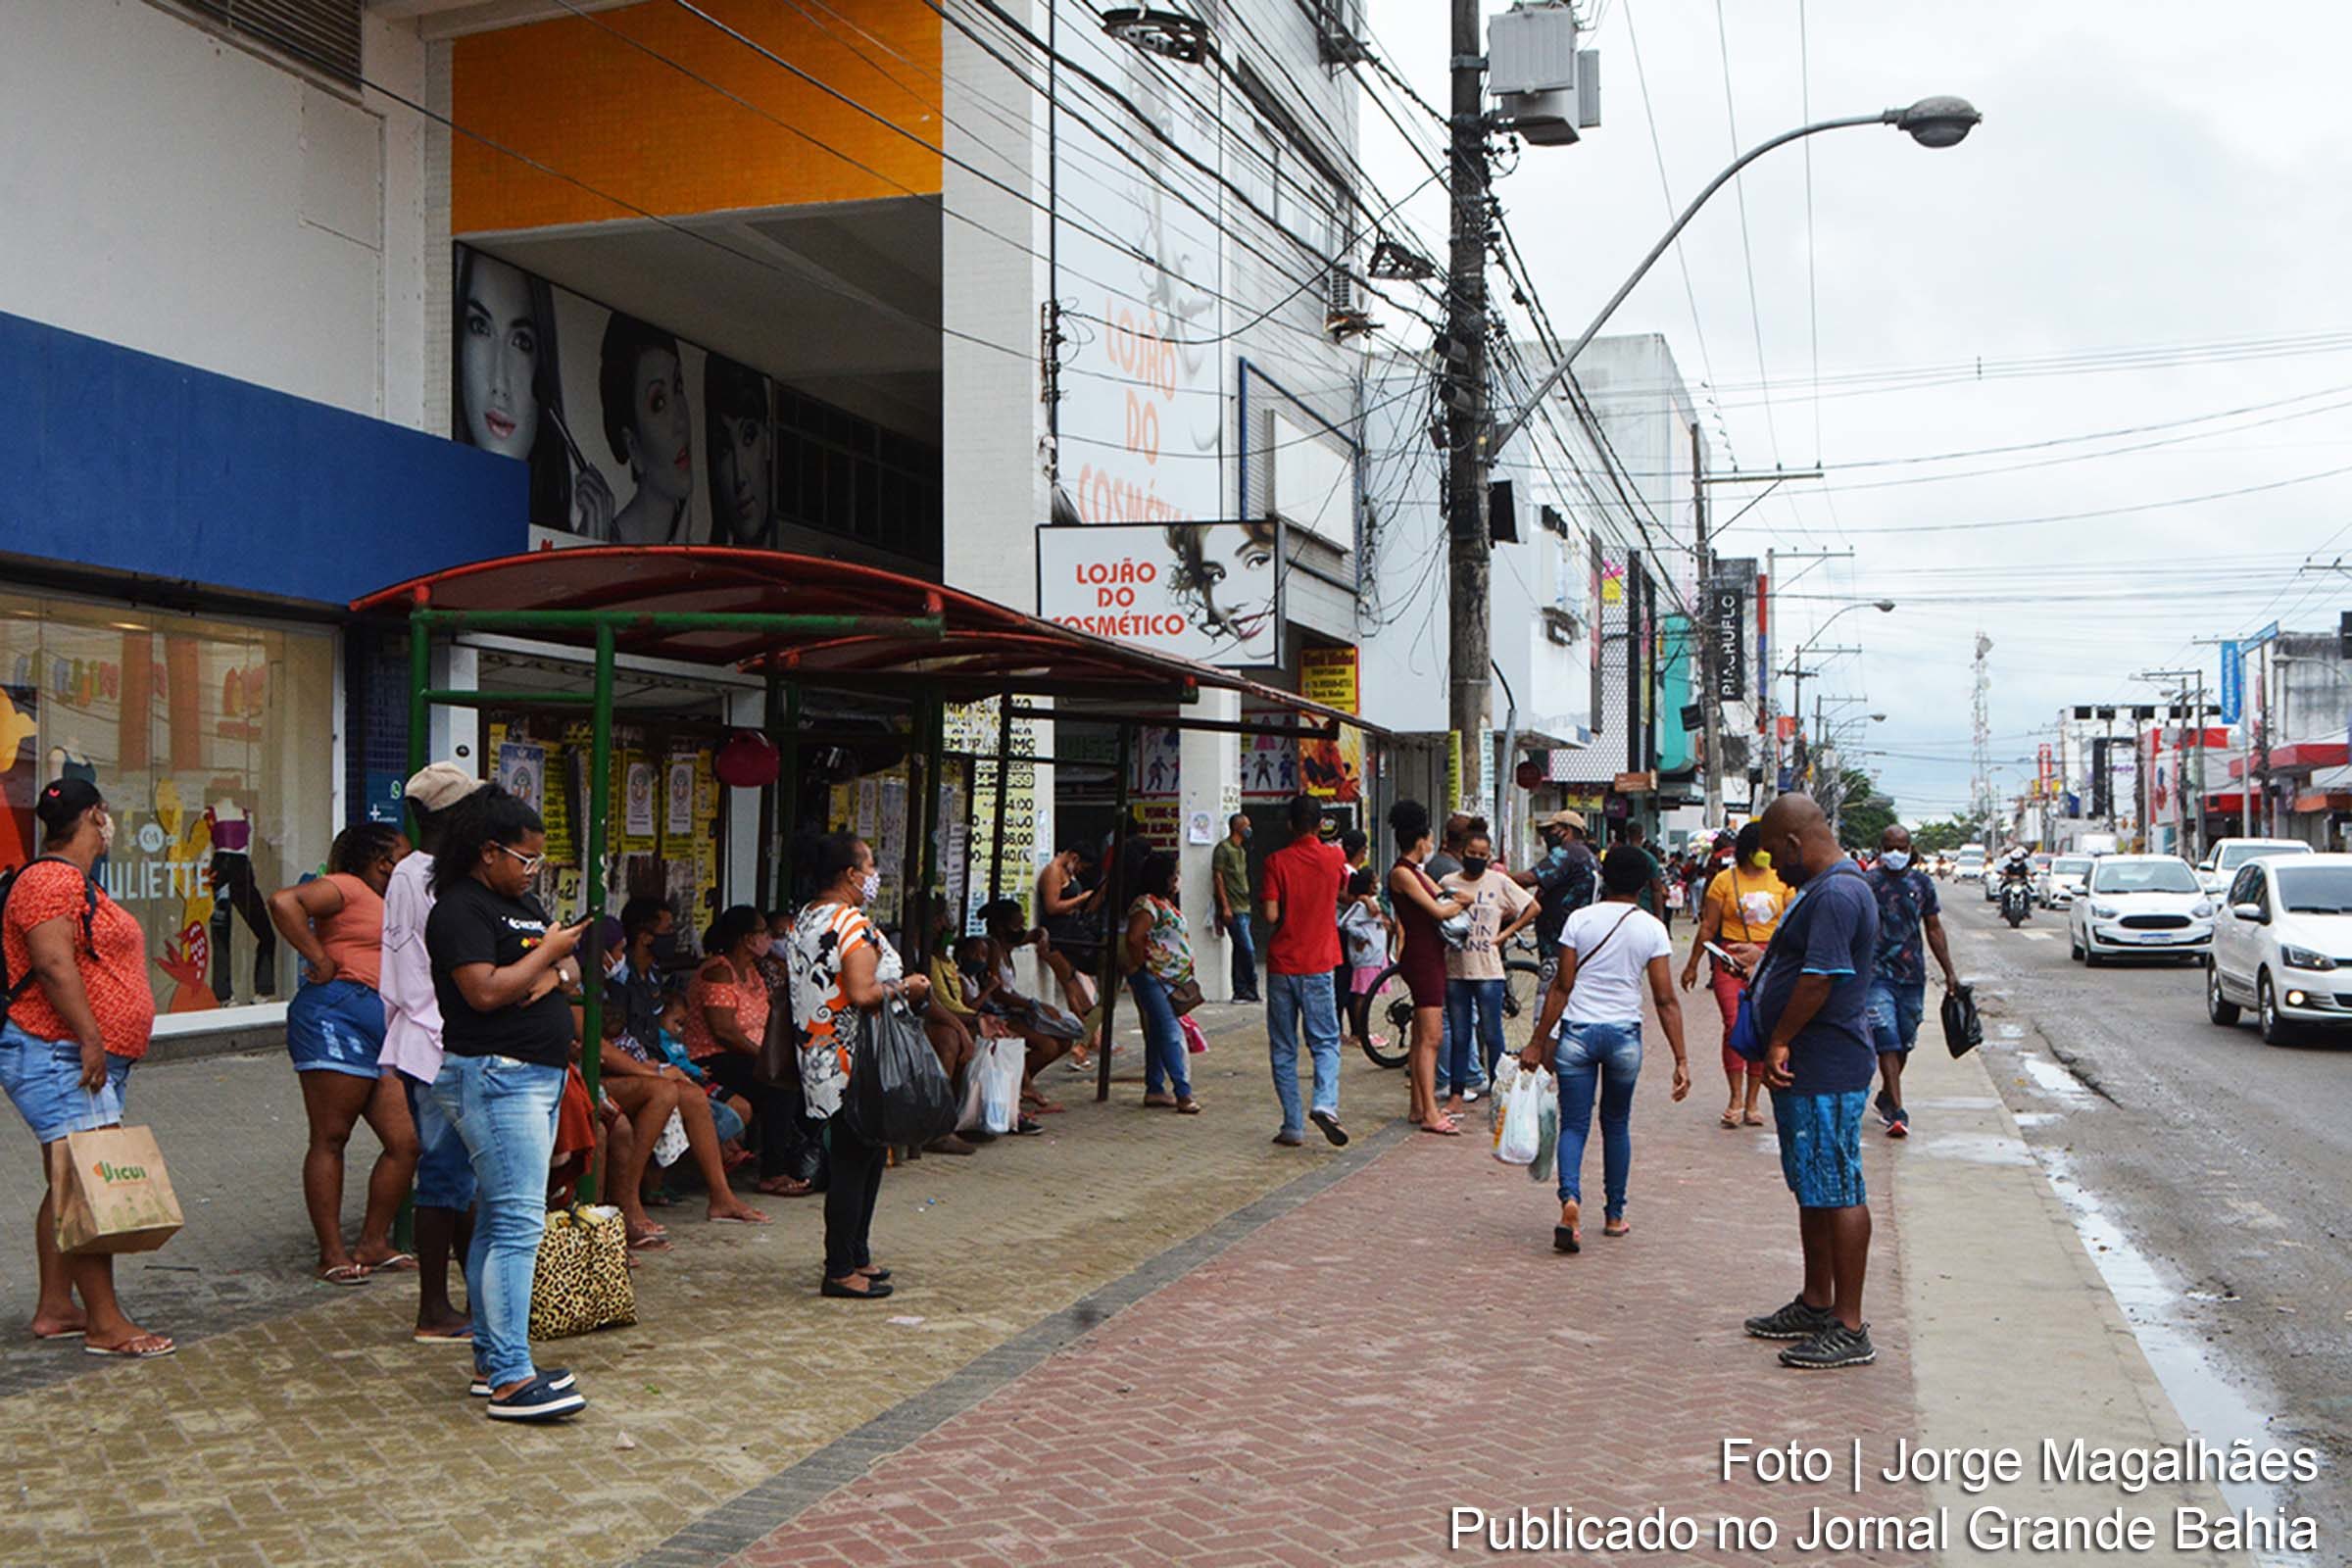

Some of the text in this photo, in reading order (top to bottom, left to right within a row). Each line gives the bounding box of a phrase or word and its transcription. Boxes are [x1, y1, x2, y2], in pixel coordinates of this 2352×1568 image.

[1105, 297, 1175, 401] LOJÃO
[1128, 387, 1159, 466] DO
[1075, 558, 1156, 585] LOJÃO
[1097, 587, 1136, 608] DO
